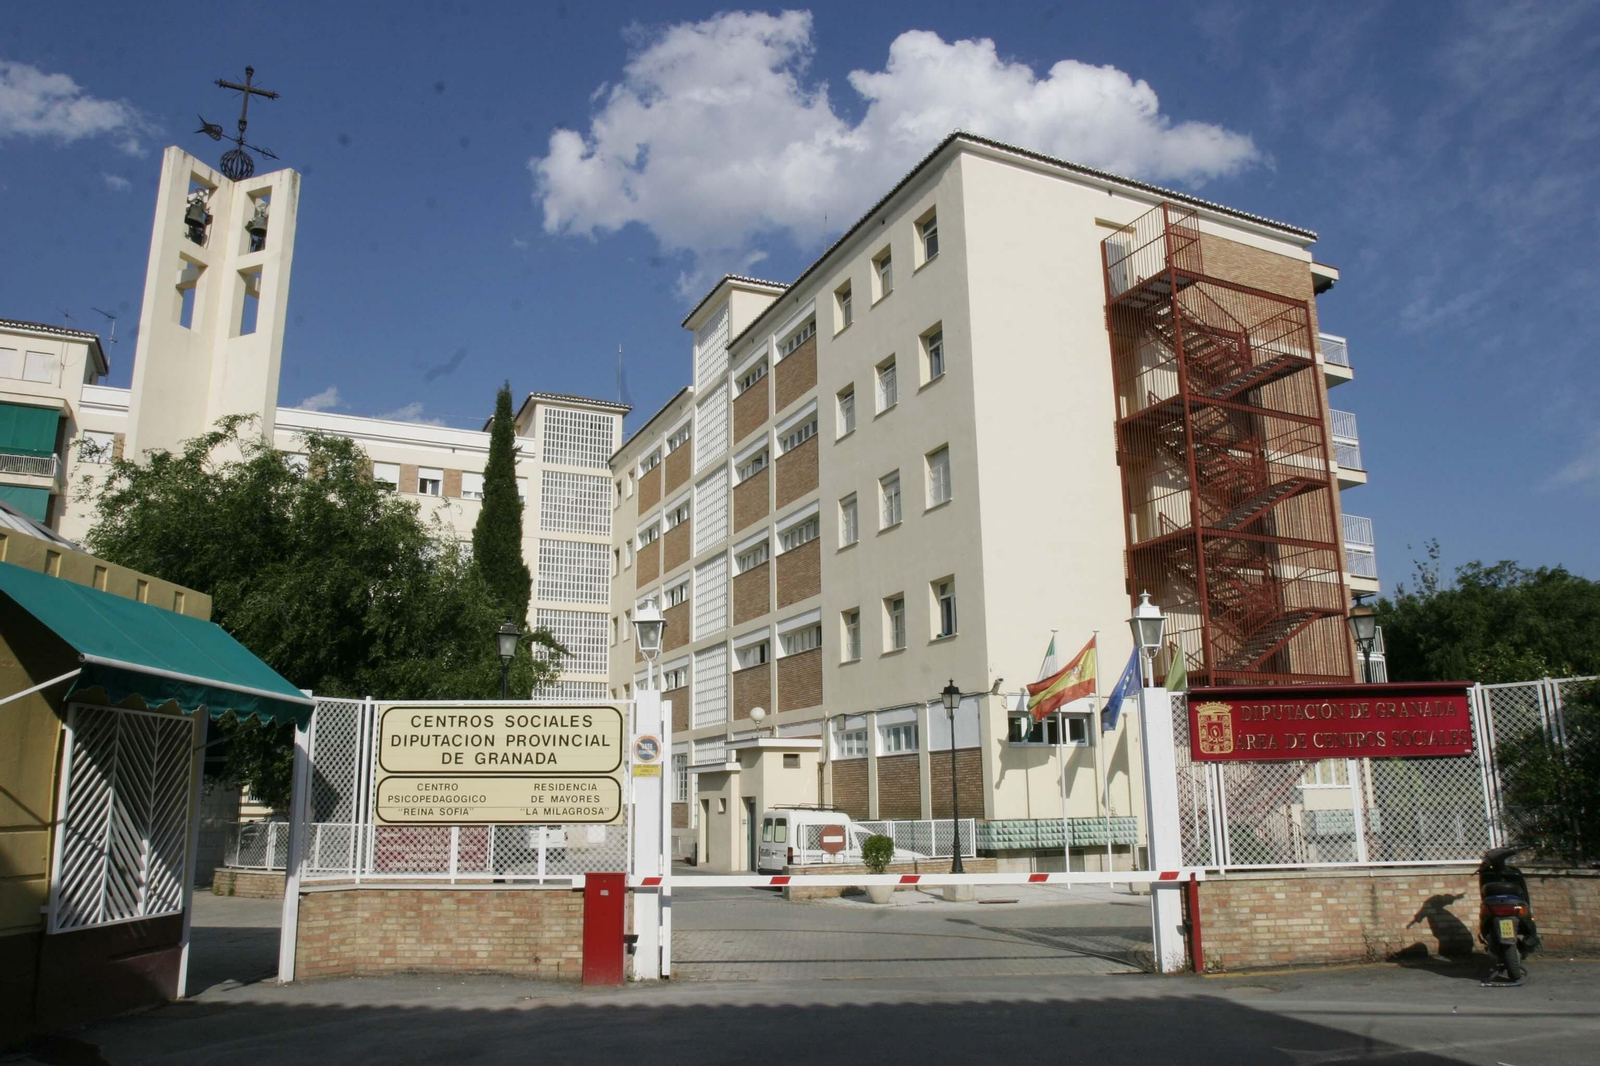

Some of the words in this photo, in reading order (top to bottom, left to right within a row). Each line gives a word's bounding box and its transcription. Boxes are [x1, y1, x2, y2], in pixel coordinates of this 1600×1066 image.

[1240, 700, 1345, 721] DIPUTACIÓN
[1349, 702, 1371, 719] DE
[1375, 701, 1457, 718] GRANADA
[410, 715, 494, 728] CENTROS
[504, 715, 593, 728] SOCIALES
[390, 734, 495, 747] DIPUTACION
[506, 734, 611, 747] PROVINCIAL
[1235, 730, 1279, 750] ÁREA
[1284, 733, 1308, 749] DE
[1313, 731, 1386, 748] CENTROS
[1391, 729, 1469, 746] SOCIALES
[441, 752, 464, 765] DE
[474, 752, 558, 765] GRANADA
[416, 783, 459, 791] CENTRO
[533, 783, 598, 791] RESIDENCIA
[387, 795, 487, 803] PSICOPEDAGOGICO
[530, 795, 545, 803] DE
[550, 795, 600, 803] MAYORES
